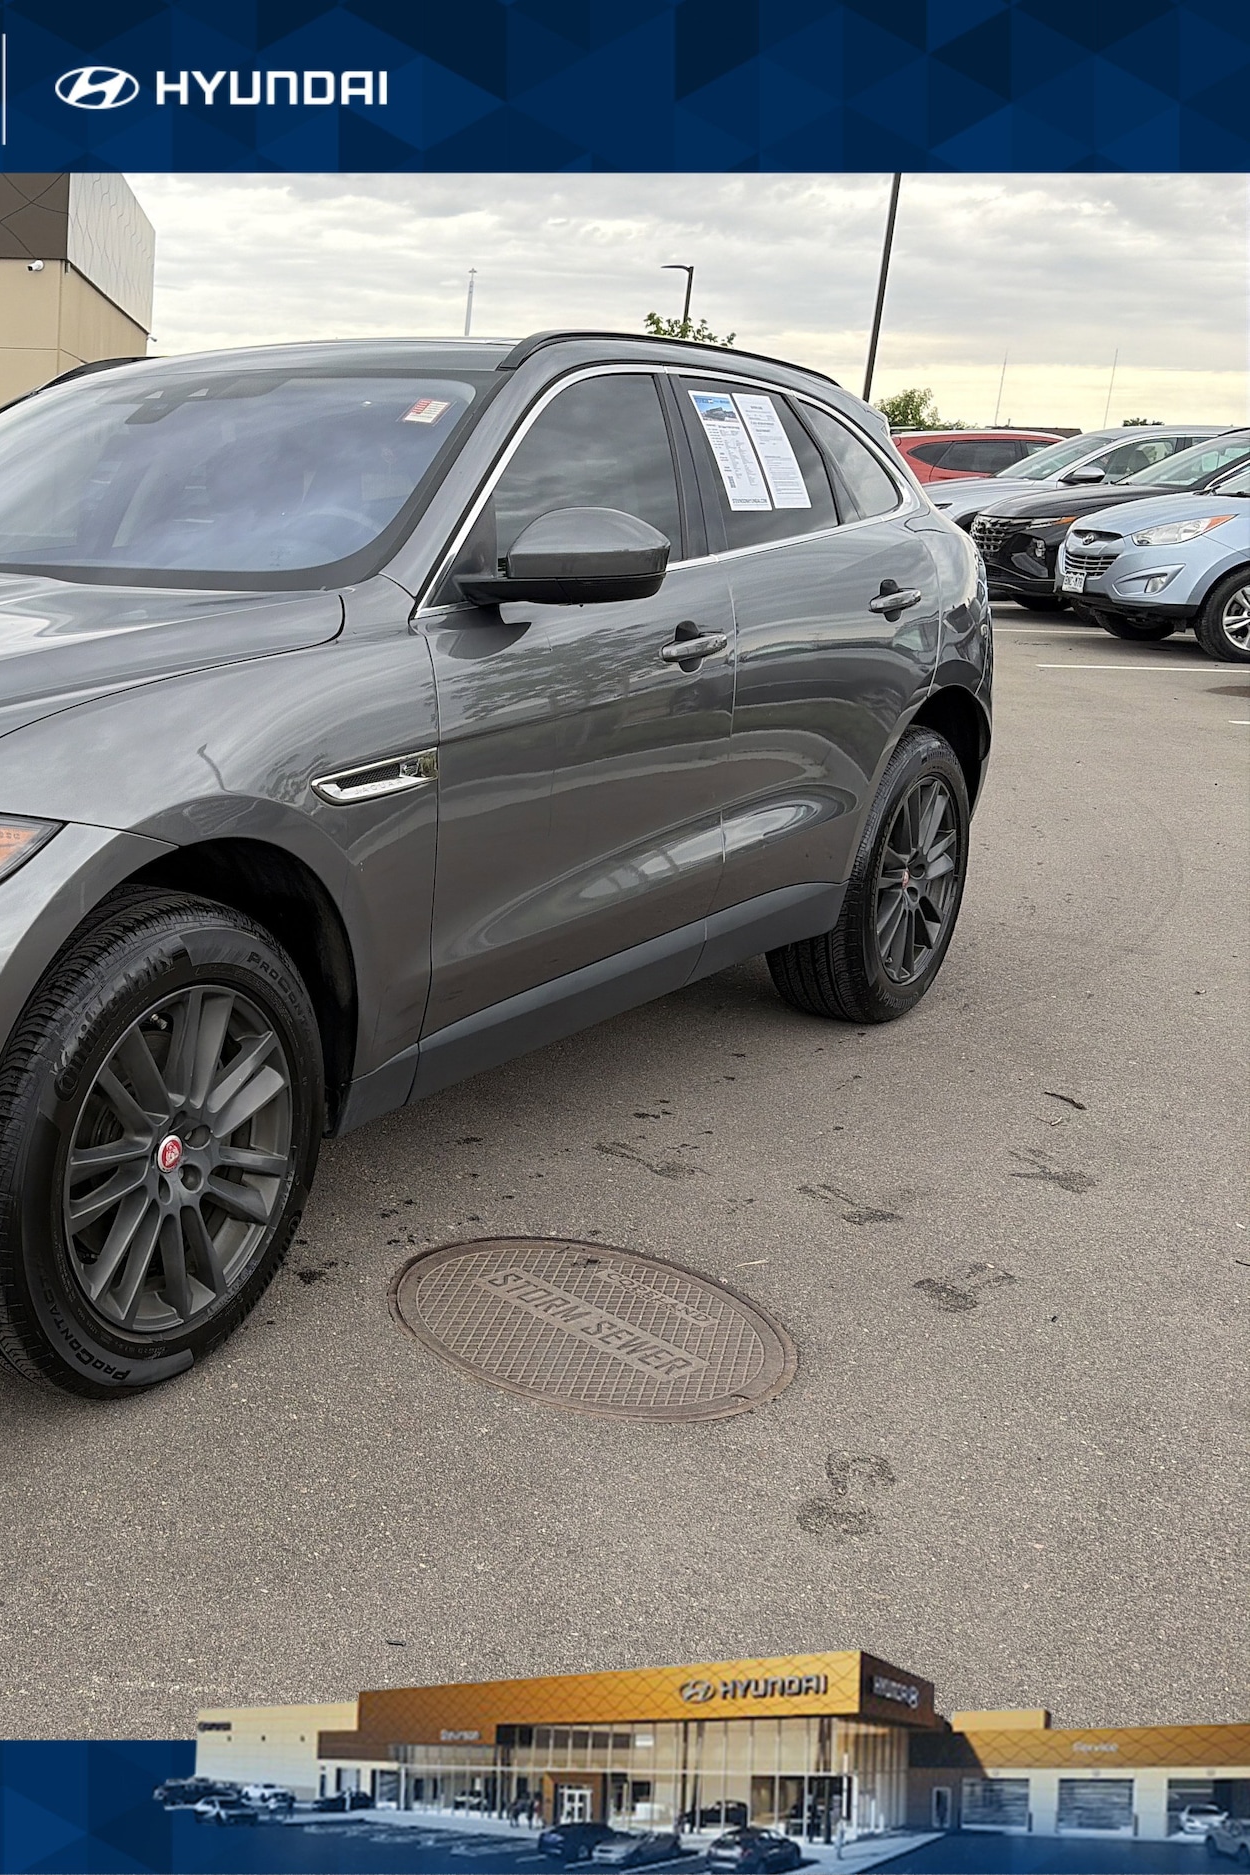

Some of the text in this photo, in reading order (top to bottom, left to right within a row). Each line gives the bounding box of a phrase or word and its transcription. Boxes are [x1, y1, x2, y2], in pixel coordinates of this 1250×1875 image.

[354, 778, 403, 795] JAGUAR
[487, 1272, 594, 1323] STORM
[581, 1320, 695, 1376] SEWER
